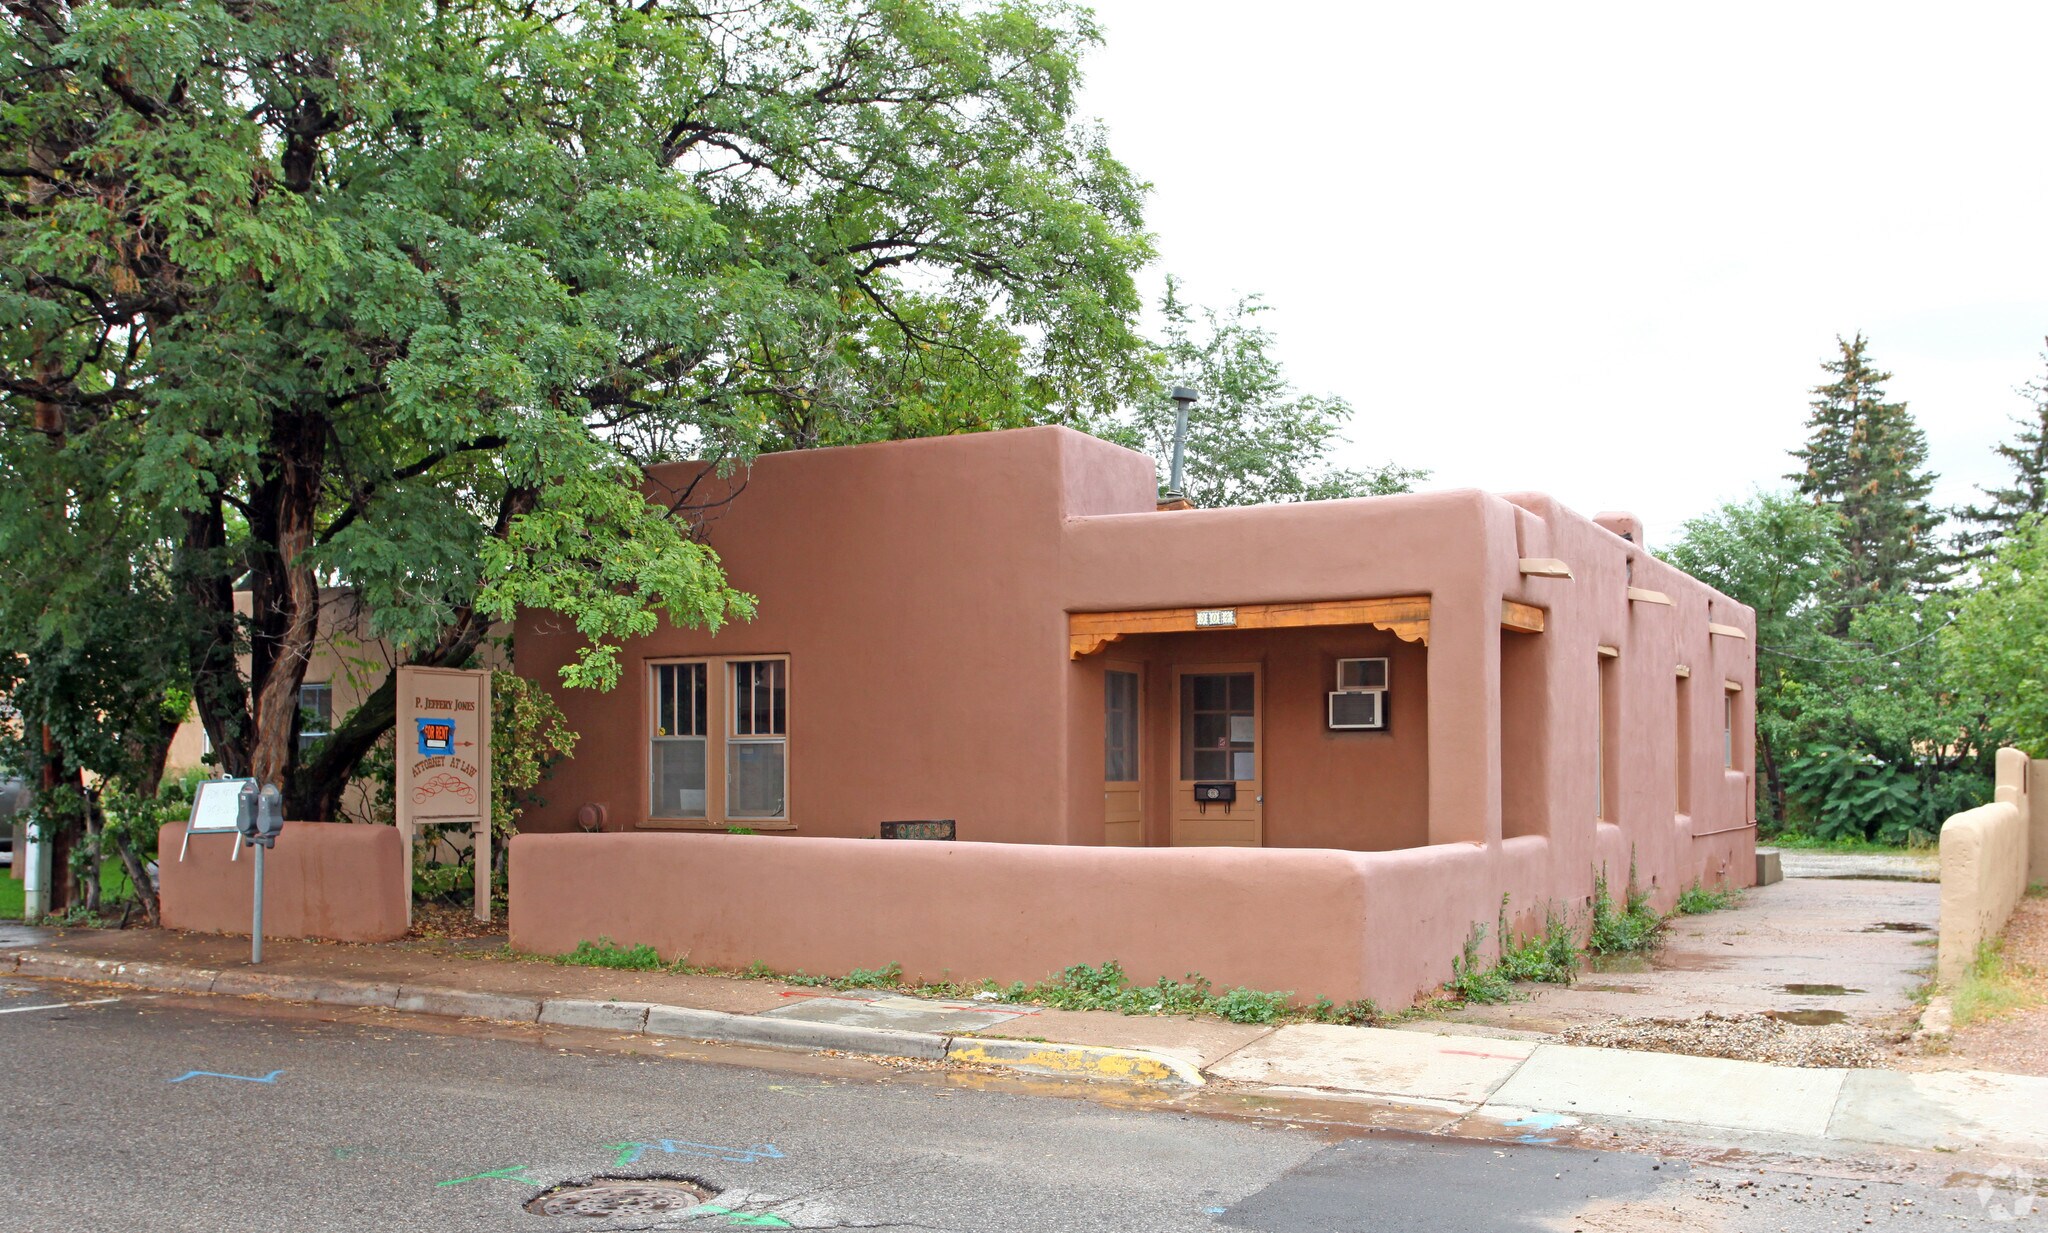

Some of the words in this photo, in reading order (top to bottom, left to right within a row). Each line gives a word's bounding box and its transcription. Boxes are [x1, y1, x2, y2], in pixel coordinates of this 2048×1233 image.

[415, 697, 423, 708] P.
[424, 697, 453, 710] JEFFERY
[454, 699, 475, 711] JONES
[425, 725, 435, 739] FOR
[435, 725, 449, 740] RENT
[412, 756, 445, 777] ATTORNEY
[450, 757, 461, 769] AT
[460, 760, 477, 777] LAW
